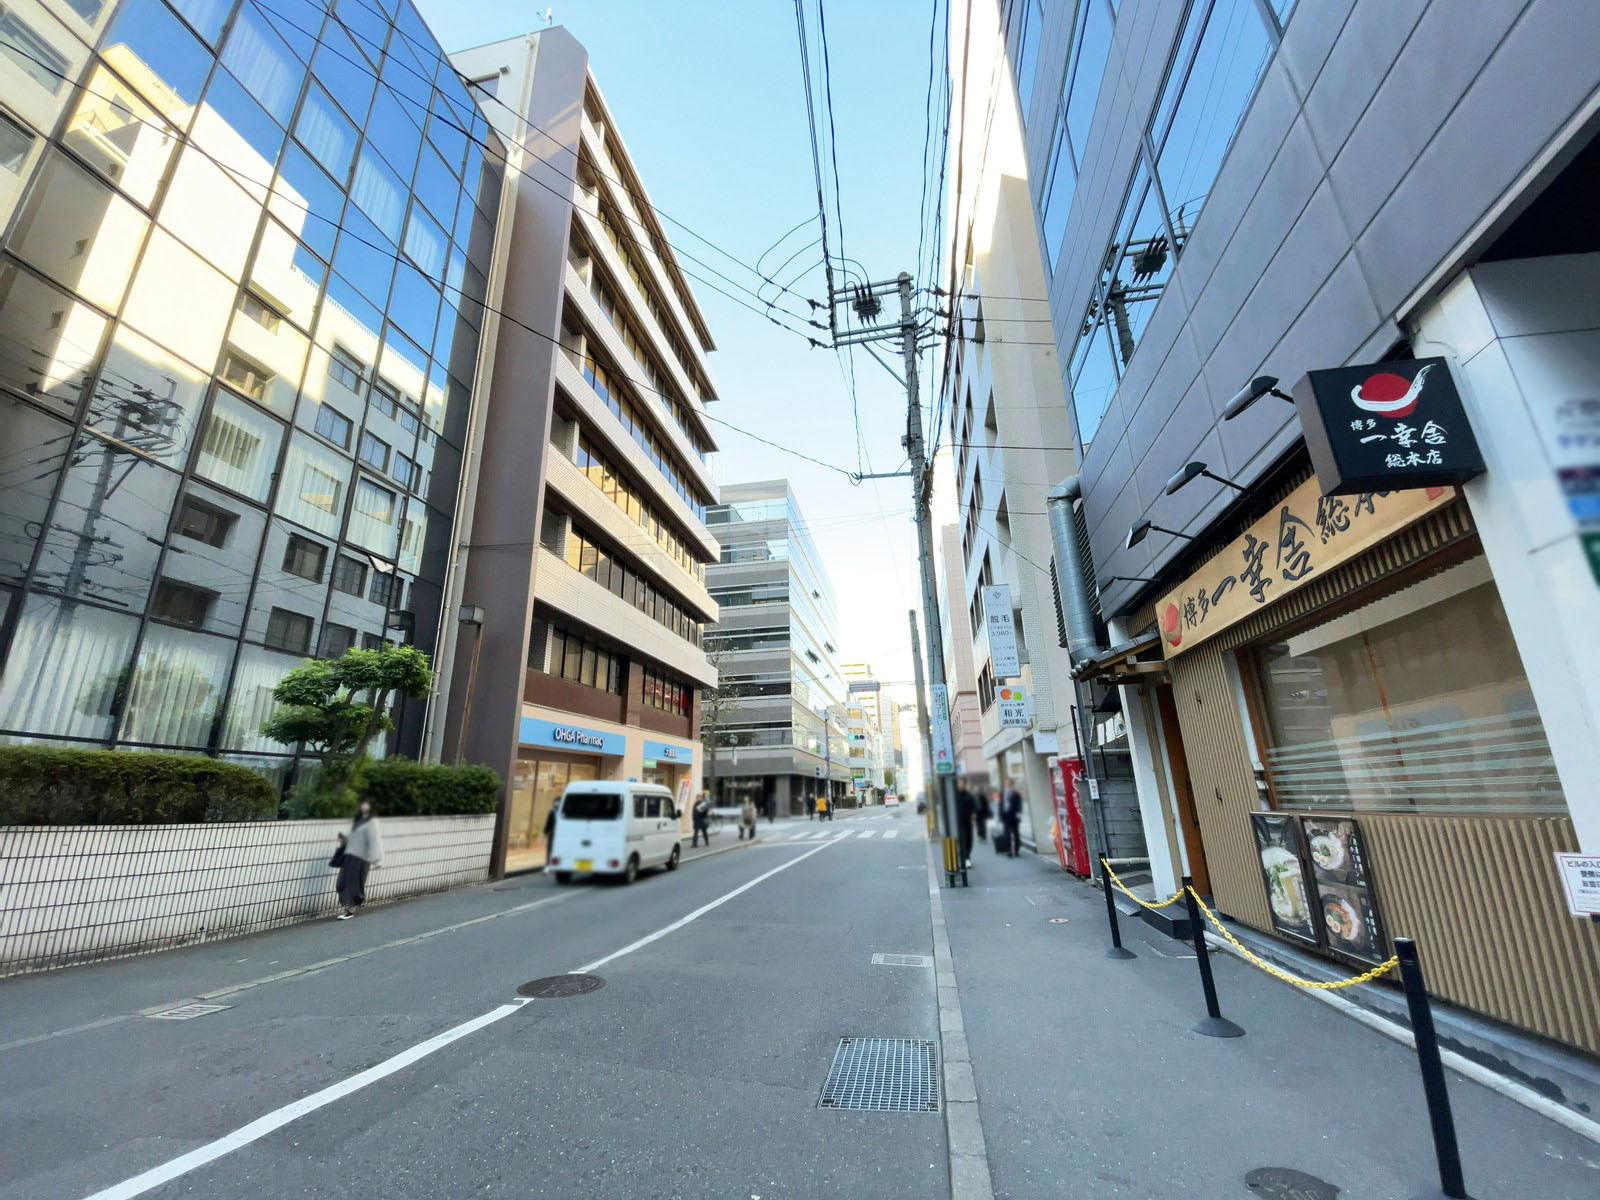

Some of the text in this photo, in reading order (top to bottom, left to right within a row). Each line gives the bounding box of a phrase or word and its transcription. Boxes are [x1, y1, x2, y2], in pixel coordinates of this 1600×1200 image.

[1350, 418, 1377, 431] 博多
[1359, 420, 1448, 448] 一幸舎
[1385, 450, 1443, 468] 総本店
[1184, 491, 1400, 630] 博多一幸舎総
[990, 614, 1010, 624] 脱毛
[1004, 708, 1024, 718] 和光
[555, 727, 605, 749] OHGA Pharmacy
